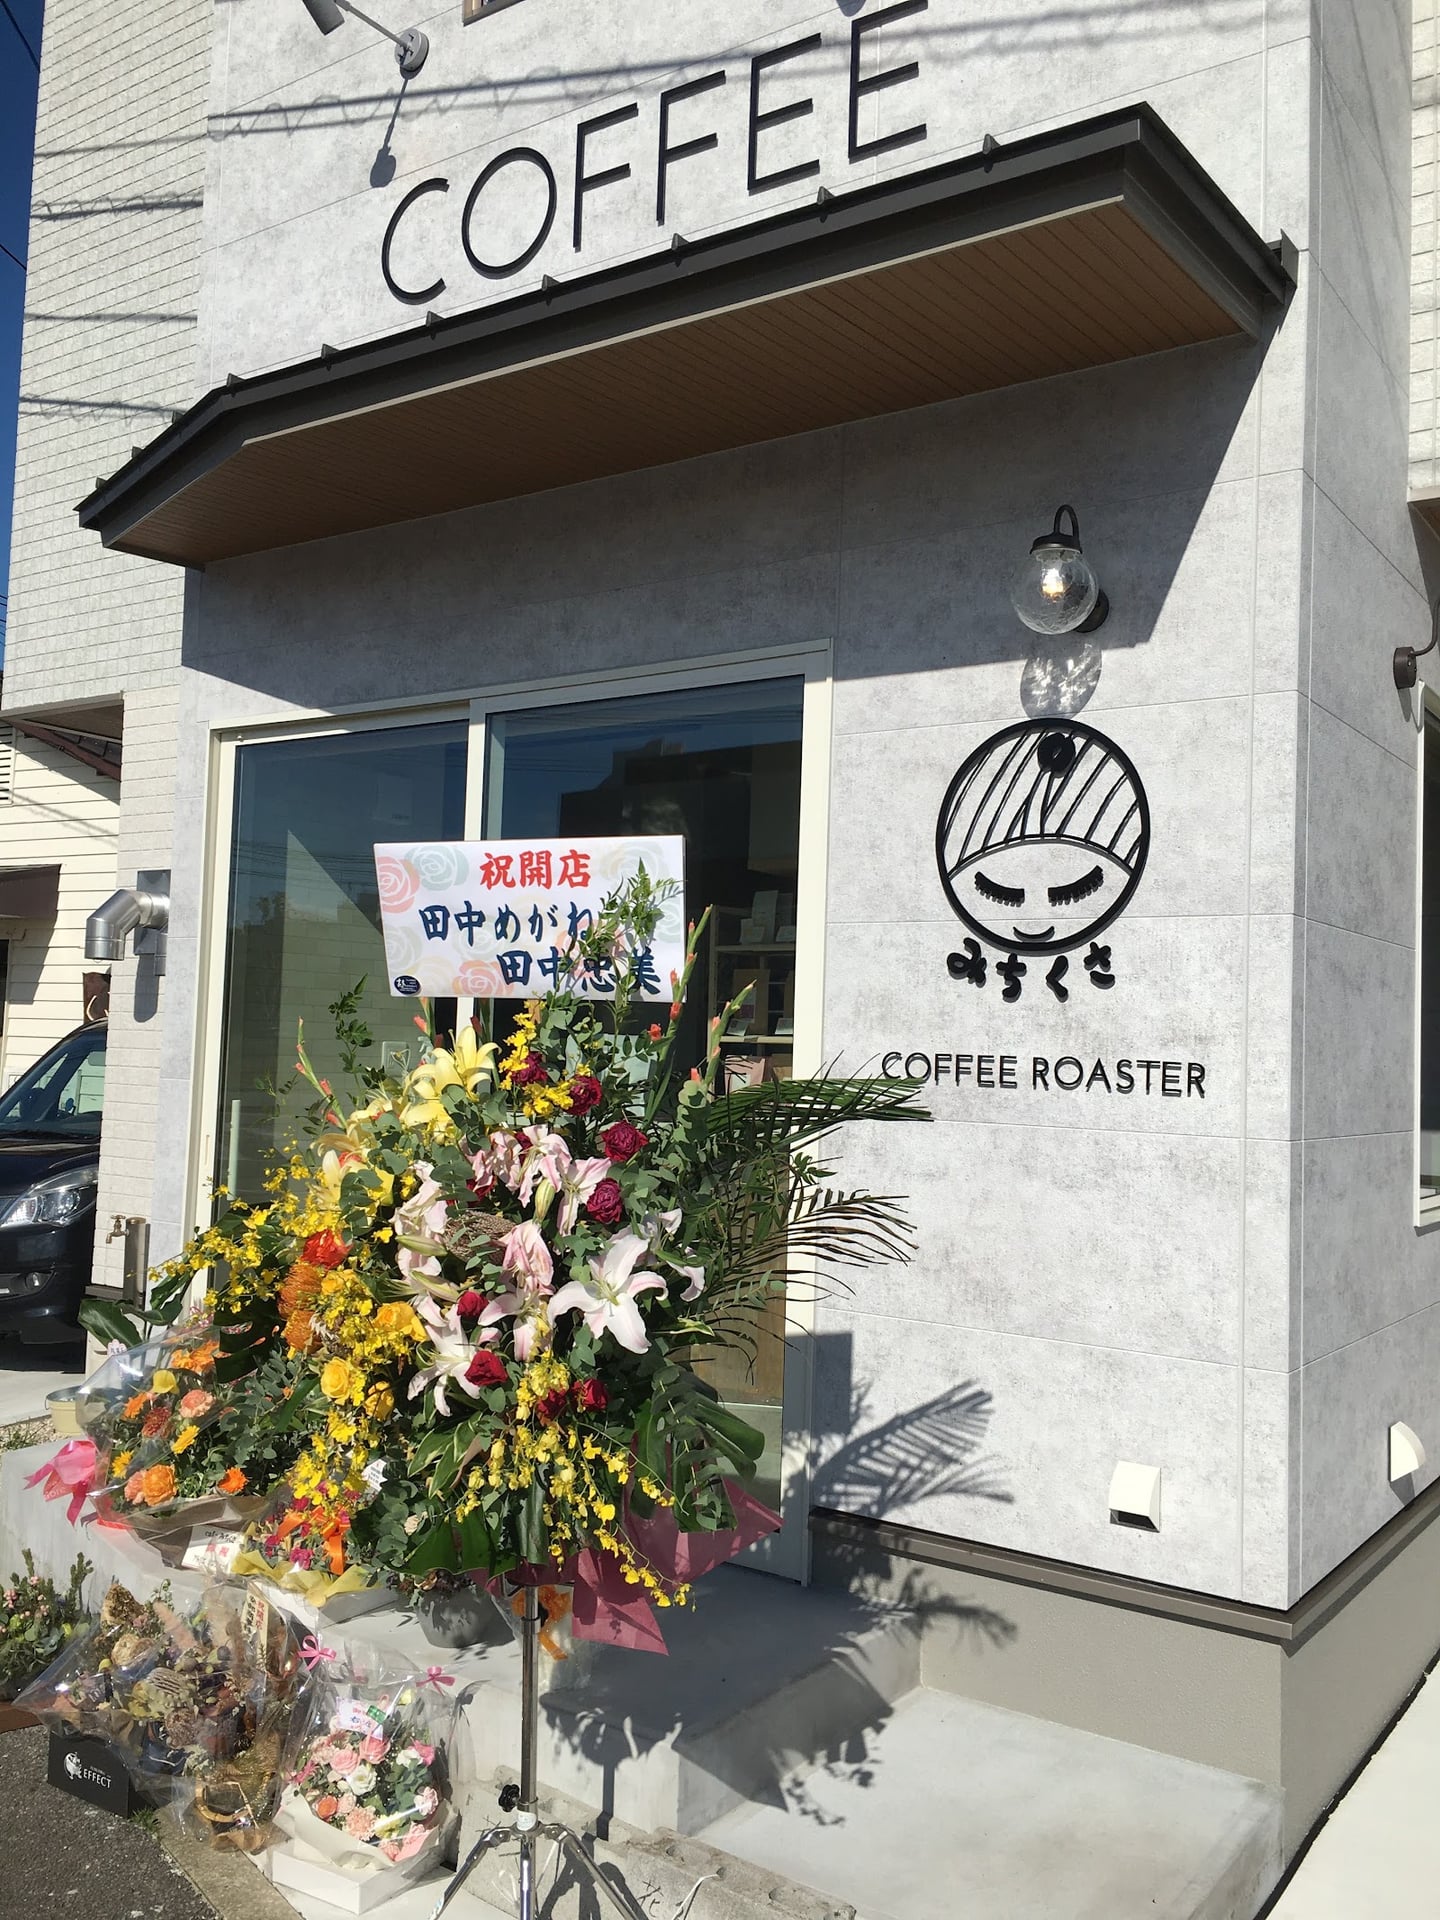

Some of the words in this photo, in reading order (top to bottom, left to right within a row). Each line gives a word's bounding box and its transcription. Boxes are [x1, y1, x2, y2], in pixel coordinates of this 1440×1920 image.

[381, 0, 928, 304] COFFEE
[480, 849, 591, 890] 祝開店
[947, 937, 1115, 1003] みちくさ
[882, 1052, 1017, 1088] COFFEE
[1032, 1056, 1205, 1098] ROASTER
[83, 1768, 112, 1788] EFFECT
